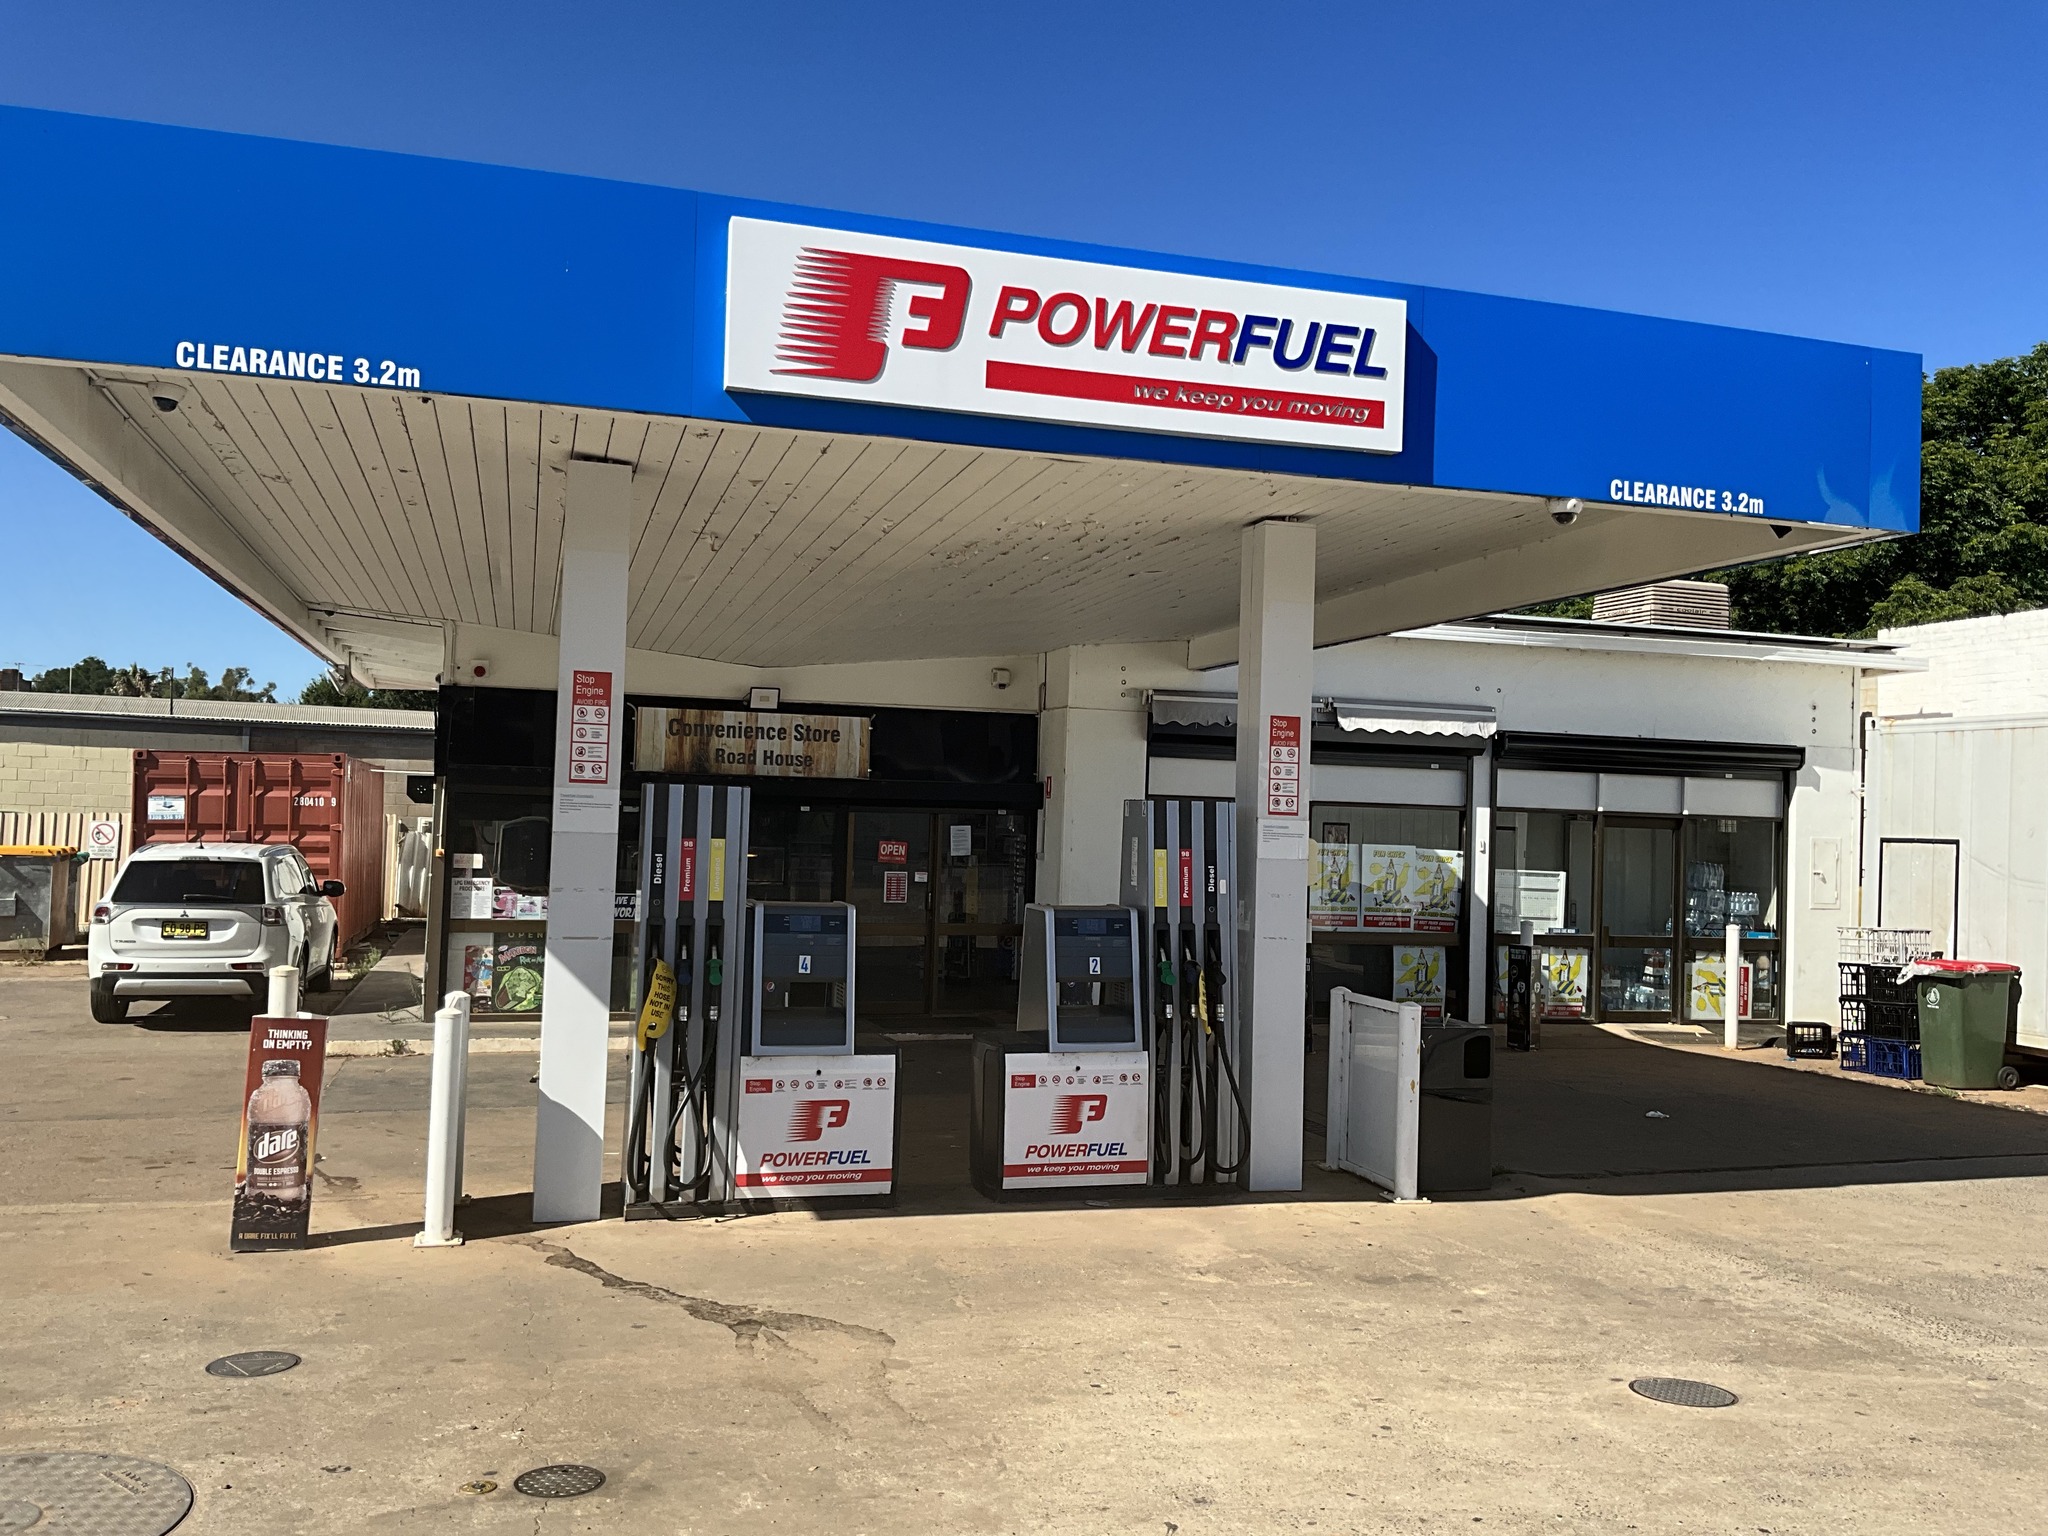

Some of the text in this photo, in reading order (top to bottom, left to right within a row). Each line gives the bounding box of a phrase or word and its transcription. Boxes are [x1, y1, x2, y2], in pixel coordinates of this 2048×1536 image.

[988, 285, 1388, 380] POWERFUEL
[175, 341, 421, 388] CLEARANCE 3.2m
[1133, 383, 1370, 425] we keep you moving
[1610, 479, 1764, 514] CLEARANCE 3.2m
[576, 674, 595, 684] Stop
[576, 685, 604, 697] Engine
[576, 698, 594, 706] AVOID
[1272, 719, 1288, 728] Stop
[668, 718, 841, 743] Convenience Store
[1272, 728, 1294, 739] Engine
[715, 748, 814, 767] Road House
[331, 797, 337, 806] 9
[880, 844, 906, 856] OPEN
[1373, 850, 1406, 858] FUN CHICK
[1434, 856, 1454, 864] CHICK
[654, 854, 663, 884] Diesel
[684, 858, 692, 892] Premium
[498, 946, 537, 965] MAXIBON
[801, 957, 808, 972] 4
[1092, 959, 1098, 973] 2
[656, 974, 674, 984] SORRY
[657, 982, 671, 992] THIS
[654, 990, 671, 1002] HOSE
[649, 1000, 671, 1010] NOT IN
[650, 1008, 664, 1018] USE
[268, 1029, 308, 1040] THINKING
[263, 1039, 312, 1050] ON EMPTY?
[257, 1128, 298, 1160] dare
[1025, 1142, 1128, 1159] POWERFUEL
[760, 1150, 871, 1167] POWERFUEL
[254, 1166, 299, 1175] DOUBLE ESPRESSO
[1043, 1165, 1066, 1173] keep
[1067, 1165, 1085, 1173] you
[1086, 1163, 1120, 1172] moving
[779, 1174, 804, 1183] keep
[826, 1172, 862, 1180] moving
[238, 1232, 243, 1240] A
[279, 1232, 290, 1240] FIX
